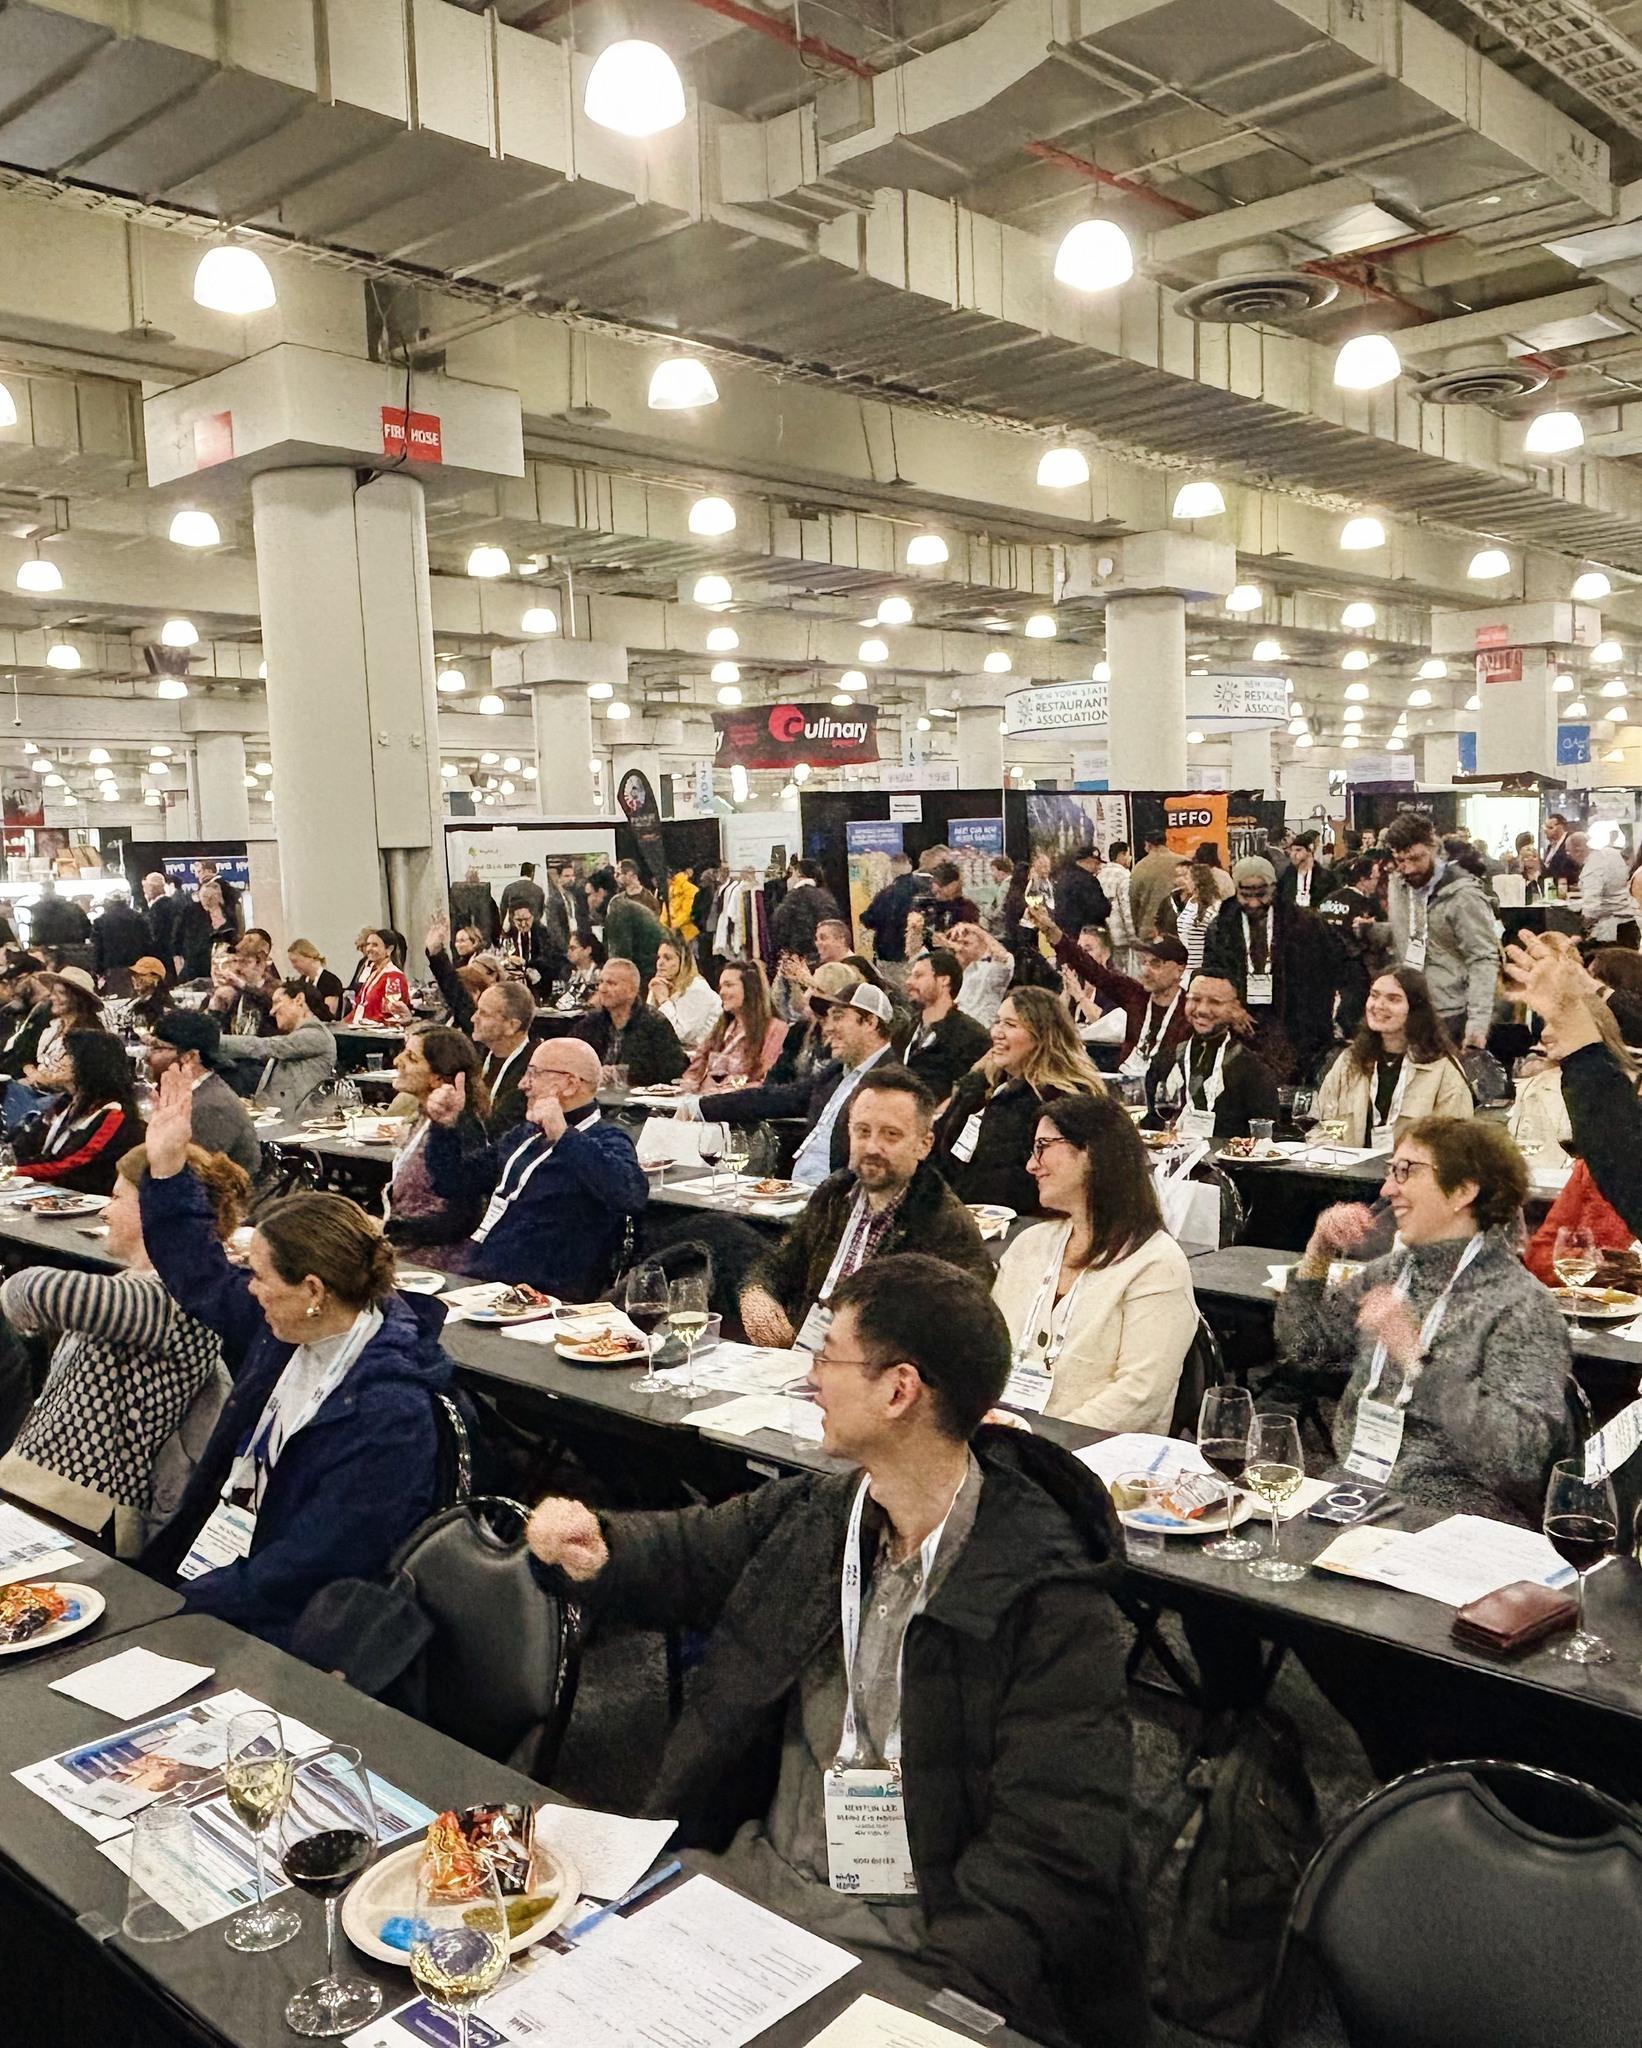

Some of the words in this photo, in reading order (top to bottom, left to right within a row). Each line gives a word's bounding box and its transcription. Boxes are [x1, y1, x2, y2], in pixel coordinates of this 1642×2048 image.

[411, 428, 439, 446] HOSE
[1036, 697, 1108, 713] RESTAURANT
[768, 703, 867, 743] Culinary
[1168, 811, 1211, 826] EFFO
